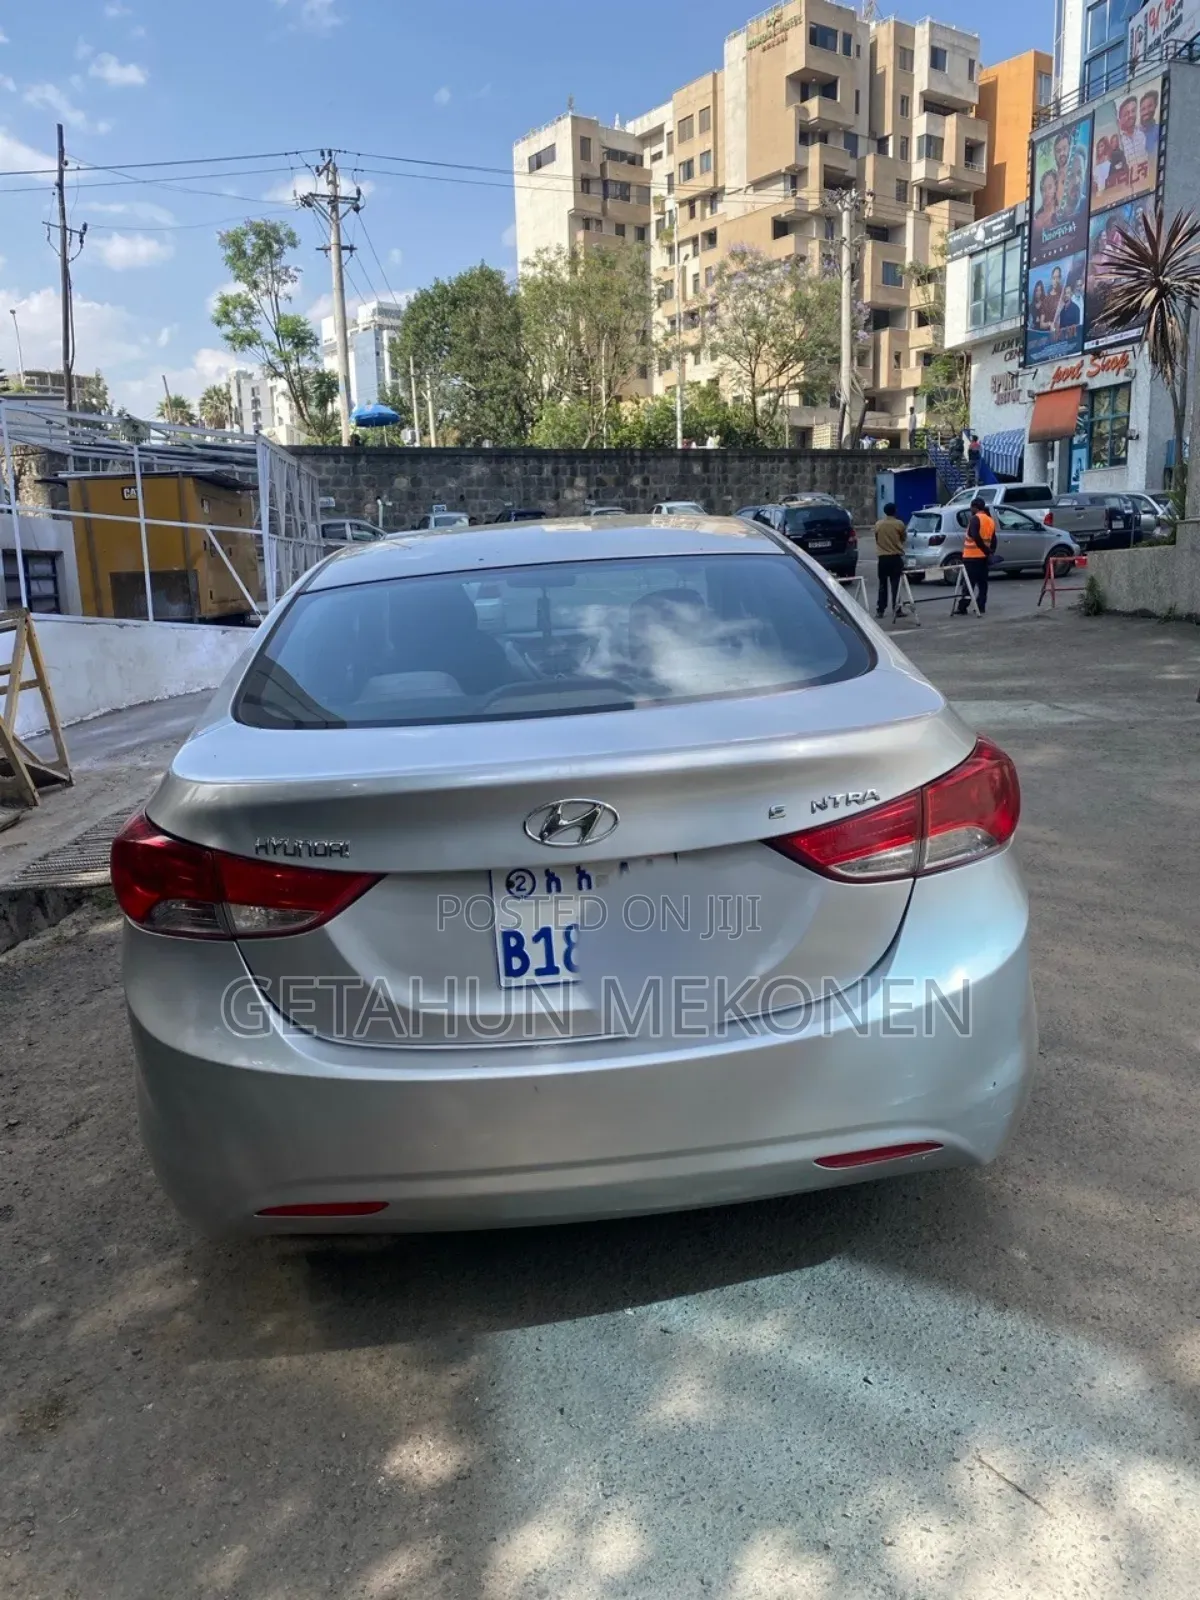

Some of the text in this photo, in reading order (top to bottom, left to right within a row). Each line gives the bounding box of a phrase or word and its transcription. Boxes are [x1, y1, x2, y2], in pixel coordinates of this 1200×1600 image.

[1086, 350, 1130, 377] Shop
[123, 488, 139, 499] CA
[811, 789, 880, 814] NTRA
[255, 837, 350, 858] HYUNDAI
